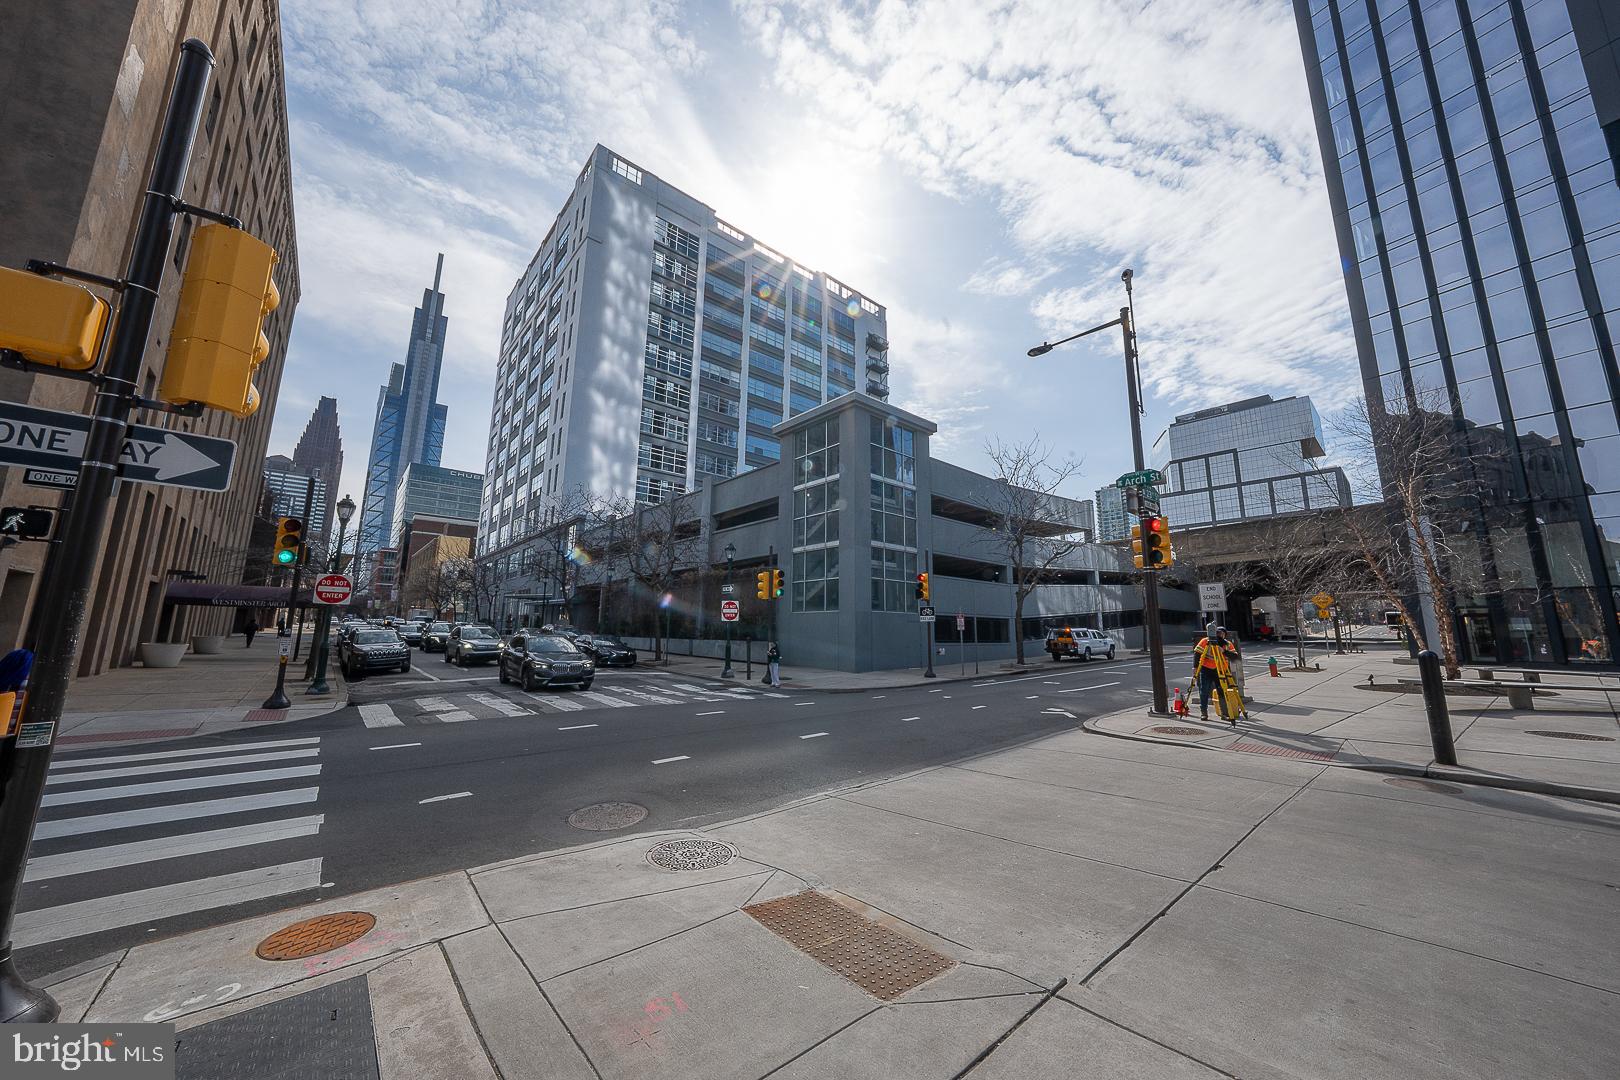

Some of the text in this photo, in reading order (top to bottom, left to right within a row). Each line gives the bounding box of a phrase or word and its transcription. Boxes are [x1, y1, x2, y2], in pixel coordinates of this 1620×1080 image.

[0, 421, 162, 465] ONE AY
[34, 472, 61, 483] ONE
[1125, 475, 1147, 486] Arch
[1150, 472, 1160, 481] St
[212, 599, 266, 607] WESTMINSTER
